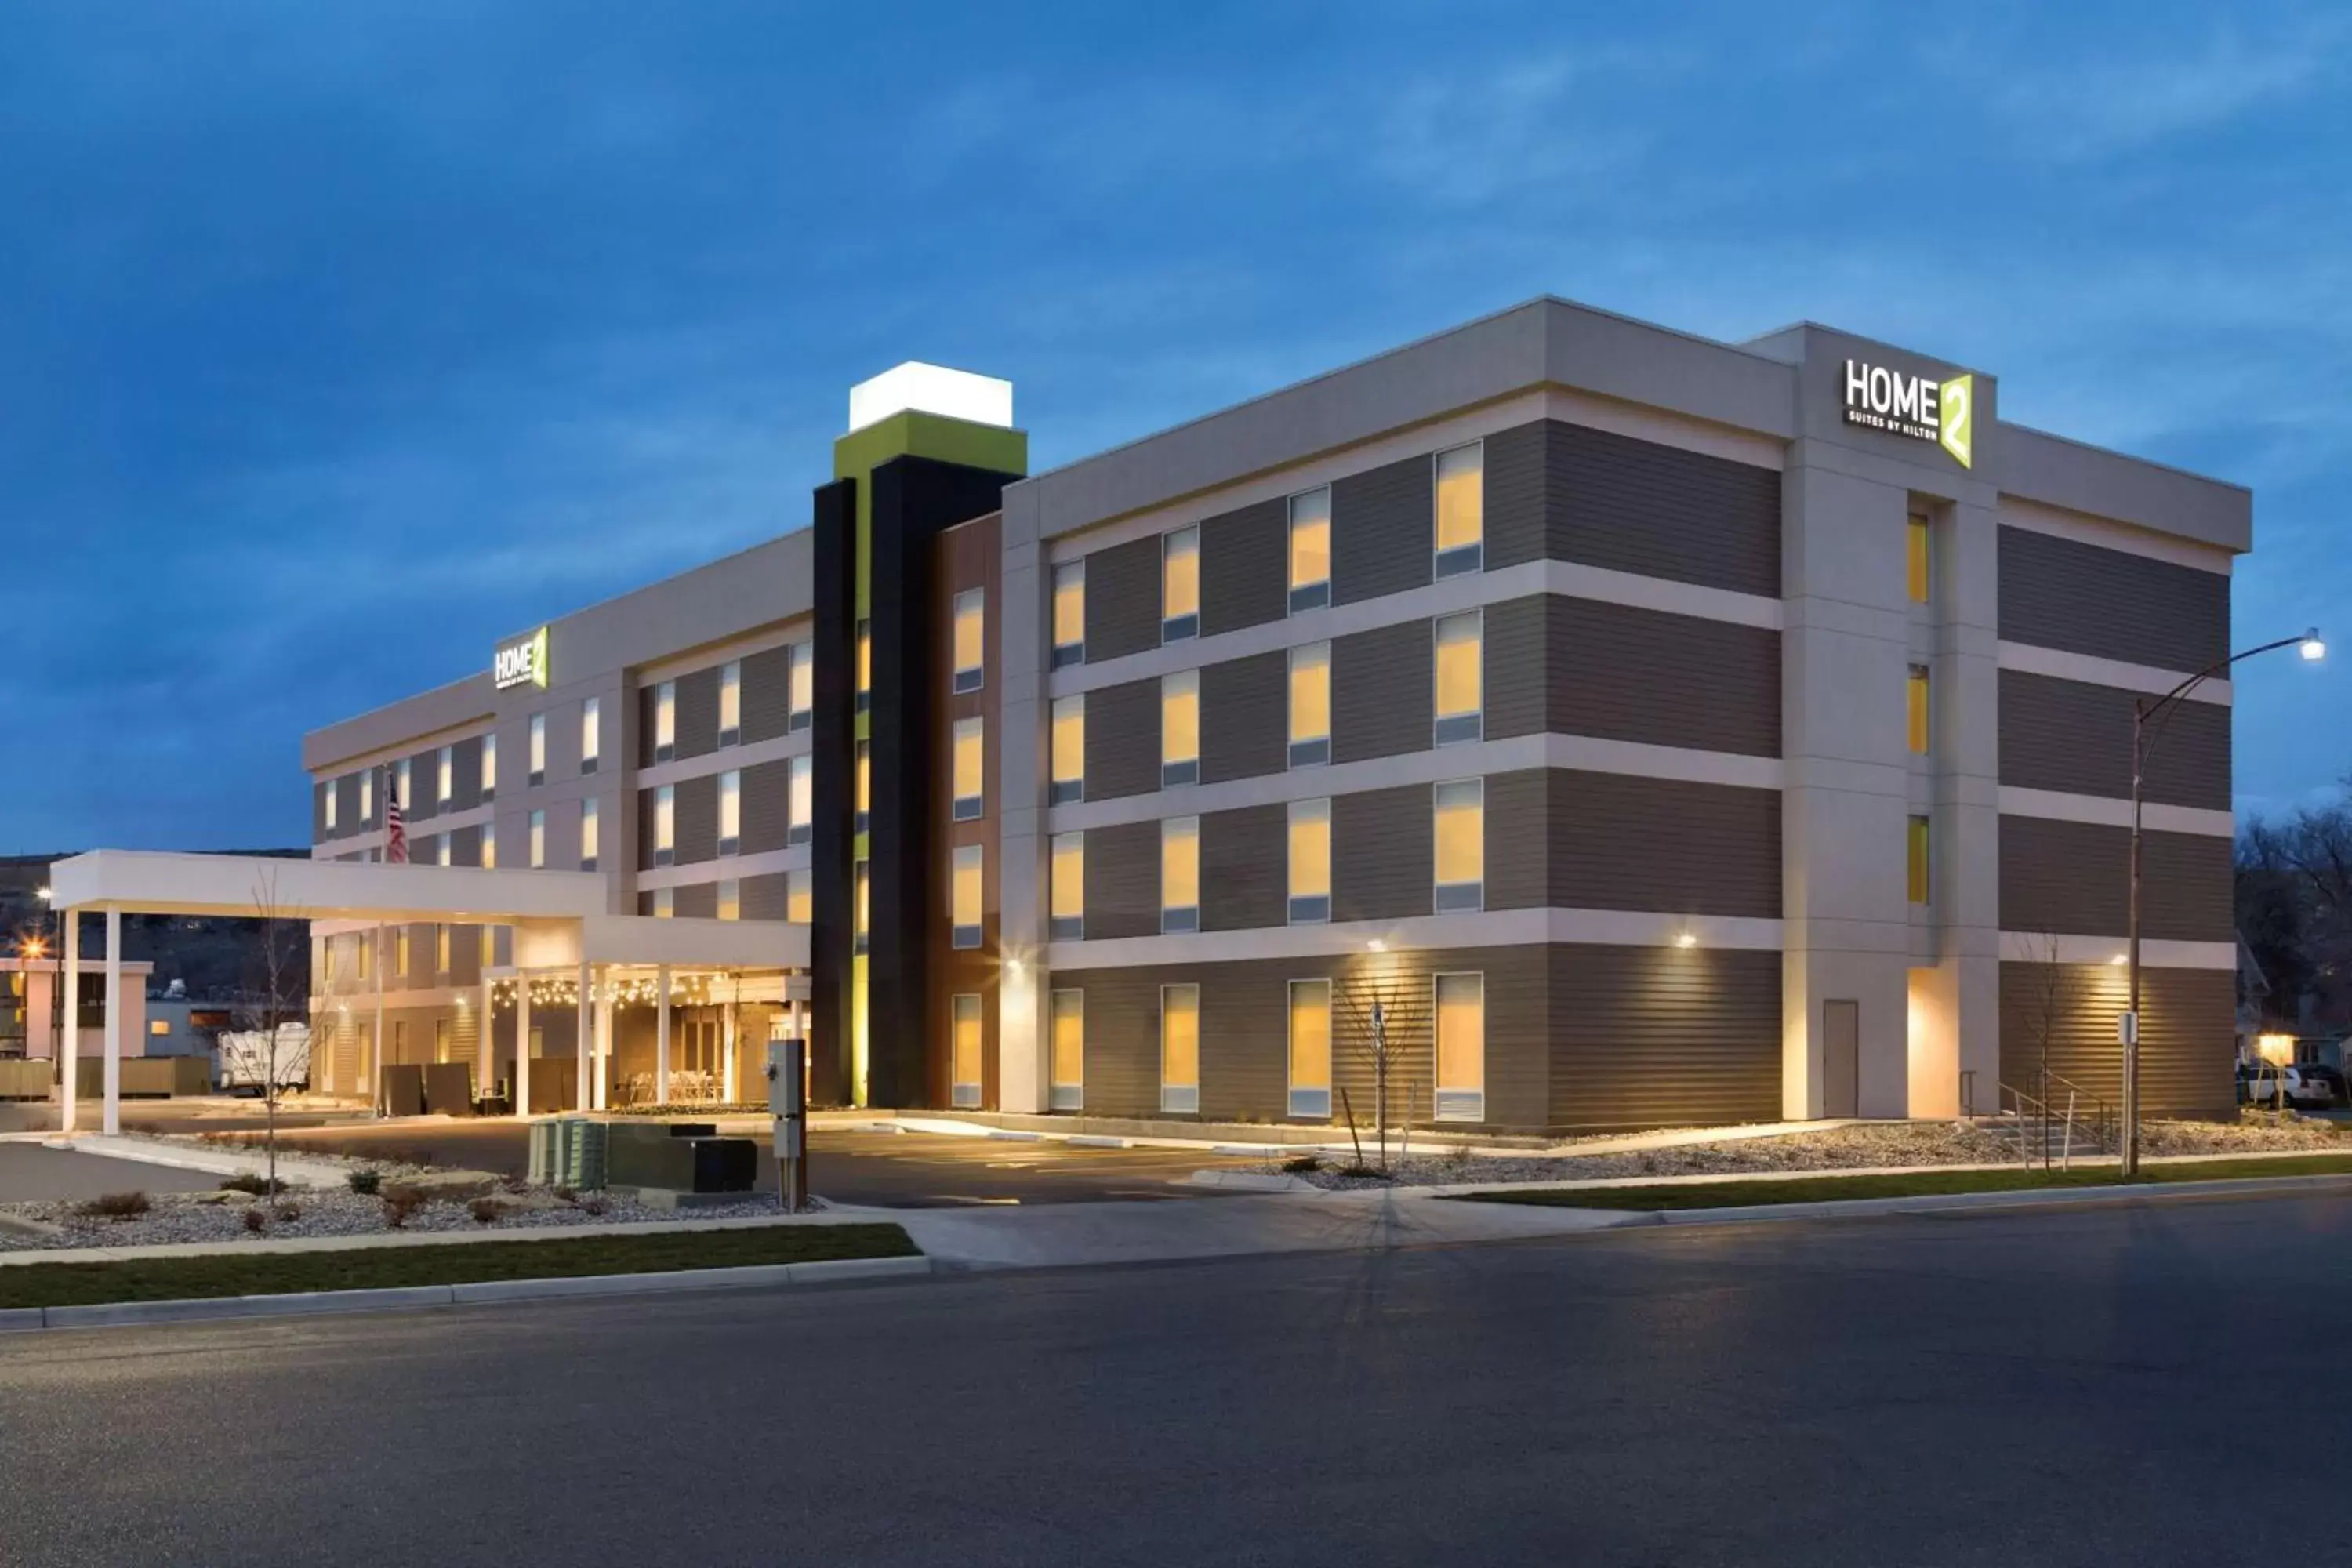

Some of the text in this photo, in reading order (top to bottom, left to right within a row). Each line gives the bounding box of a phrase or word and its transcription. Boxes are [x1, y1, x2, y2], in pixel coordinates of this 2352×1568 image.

[1849, 410, 1938, 441] SUITES BY HILTON
